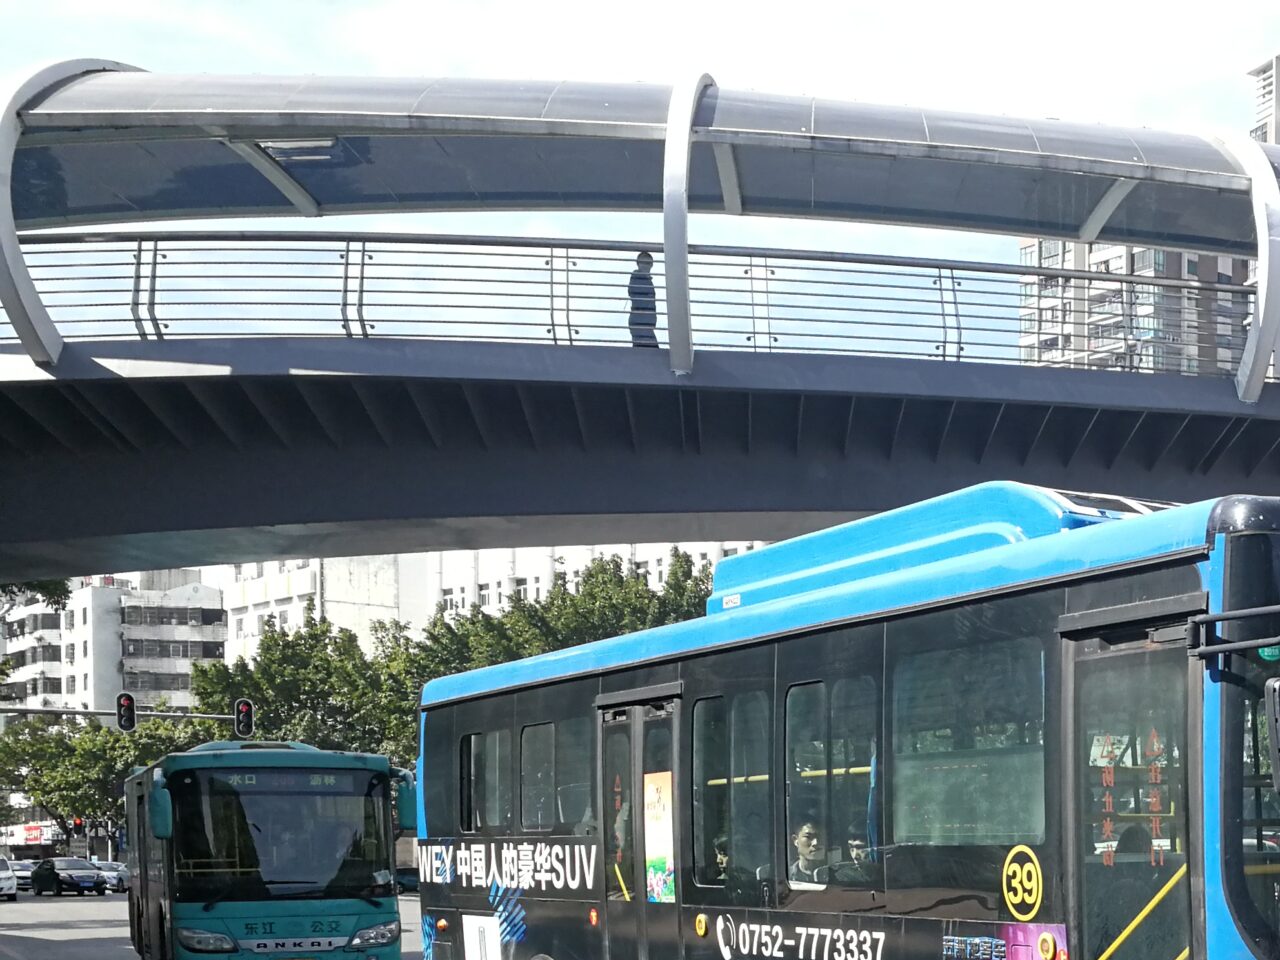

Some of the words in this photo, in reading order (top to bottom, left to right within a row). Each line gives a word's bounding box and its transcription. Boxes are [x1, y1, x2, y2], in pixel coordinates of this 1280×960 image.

[228, 774, 256, 785] 水口
[417, 845, 454, 884] WEY
[456, 842, 597, 890] 中国人的豪华SUV
[1007, 862, 1038, 904] 39
[244, 922, 277, 935] 东江
[310, 921, 342, 933] 公交
[256, 941, 333, 949] ANKAI
